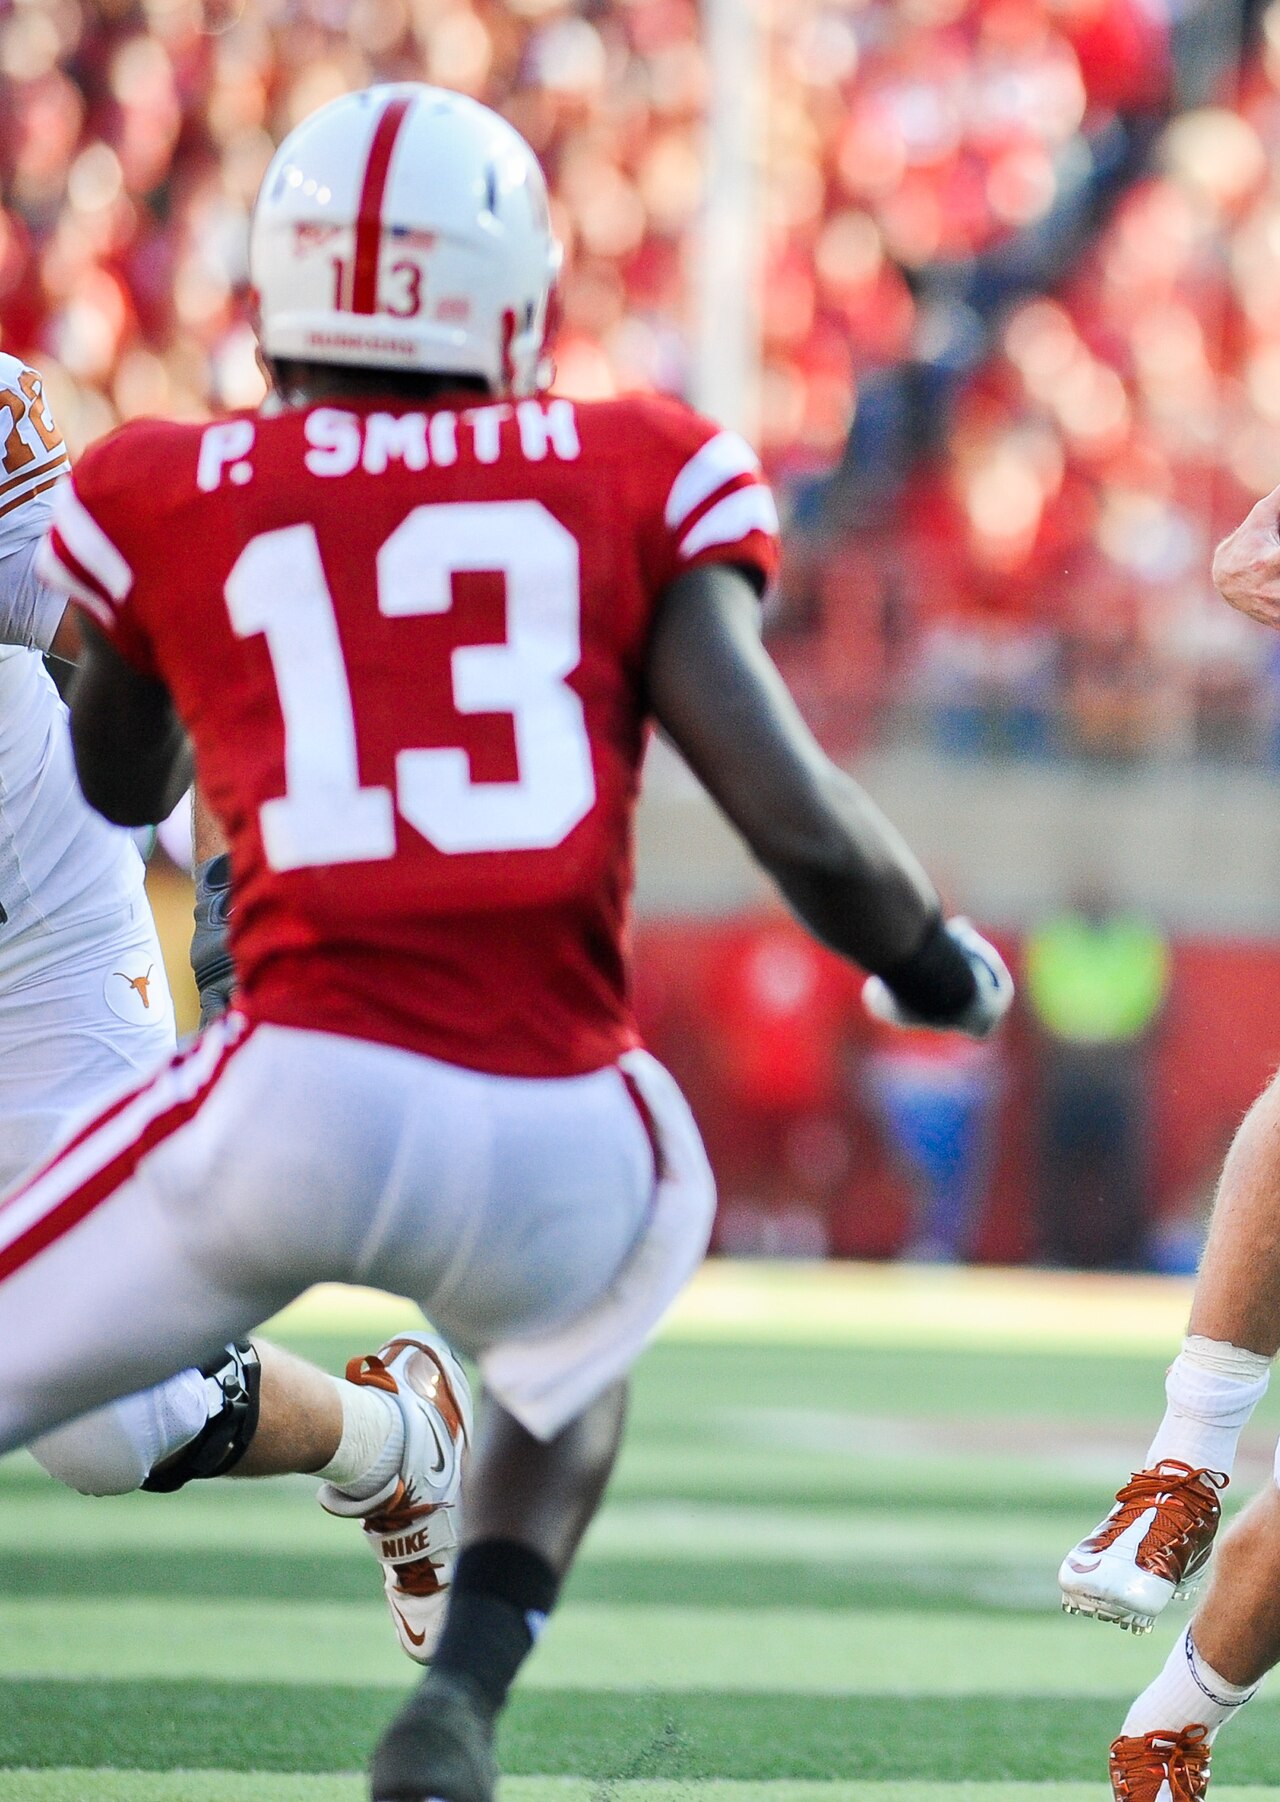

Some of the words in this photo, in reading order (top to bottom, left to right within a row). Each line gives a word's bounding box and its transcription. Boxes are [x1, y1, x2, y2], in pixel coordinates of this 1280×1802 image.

[331, 256, 422, 319] 13
[196, 418, 257, 493] P.
[303, 400, 582, 478] SMITH
[222, 499, 597, 873] 13
[381, 1526, 431, 1558] NIKE
